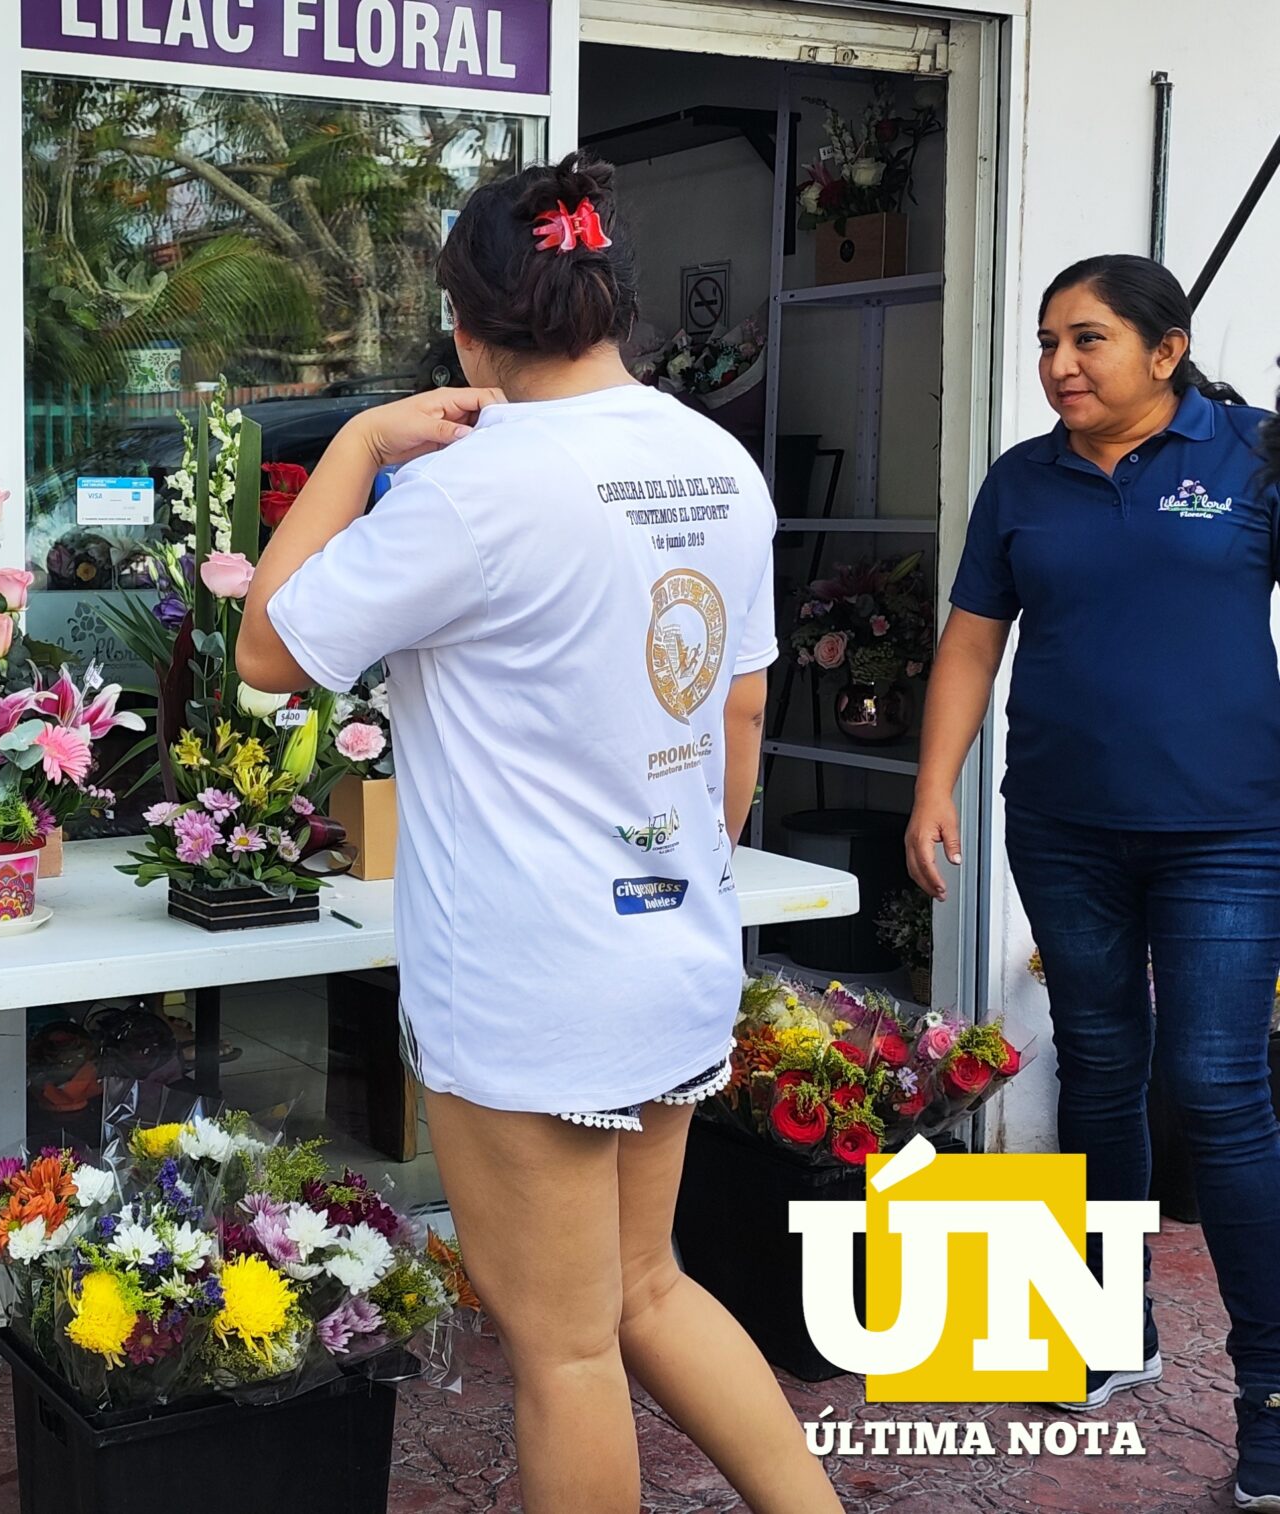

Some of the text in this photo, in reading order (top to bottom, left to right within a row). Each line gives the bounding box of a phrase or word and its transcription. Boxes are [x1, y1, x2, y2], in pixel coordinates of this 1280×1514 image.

[61, 0, 517, 79] LILAC FLORAL
[597, 474, 740, 503] CARRERA DEL DÍA DEL PADRE
[1157, 495, 1189, 511] Lilac
[679, 507, 690, 522] EL
[656, 534, 665, 549] de
[666, 532, 686, 552] junio
[687, 531, 705, 547] 2019
[647, 765, 683, 781] Promotora
